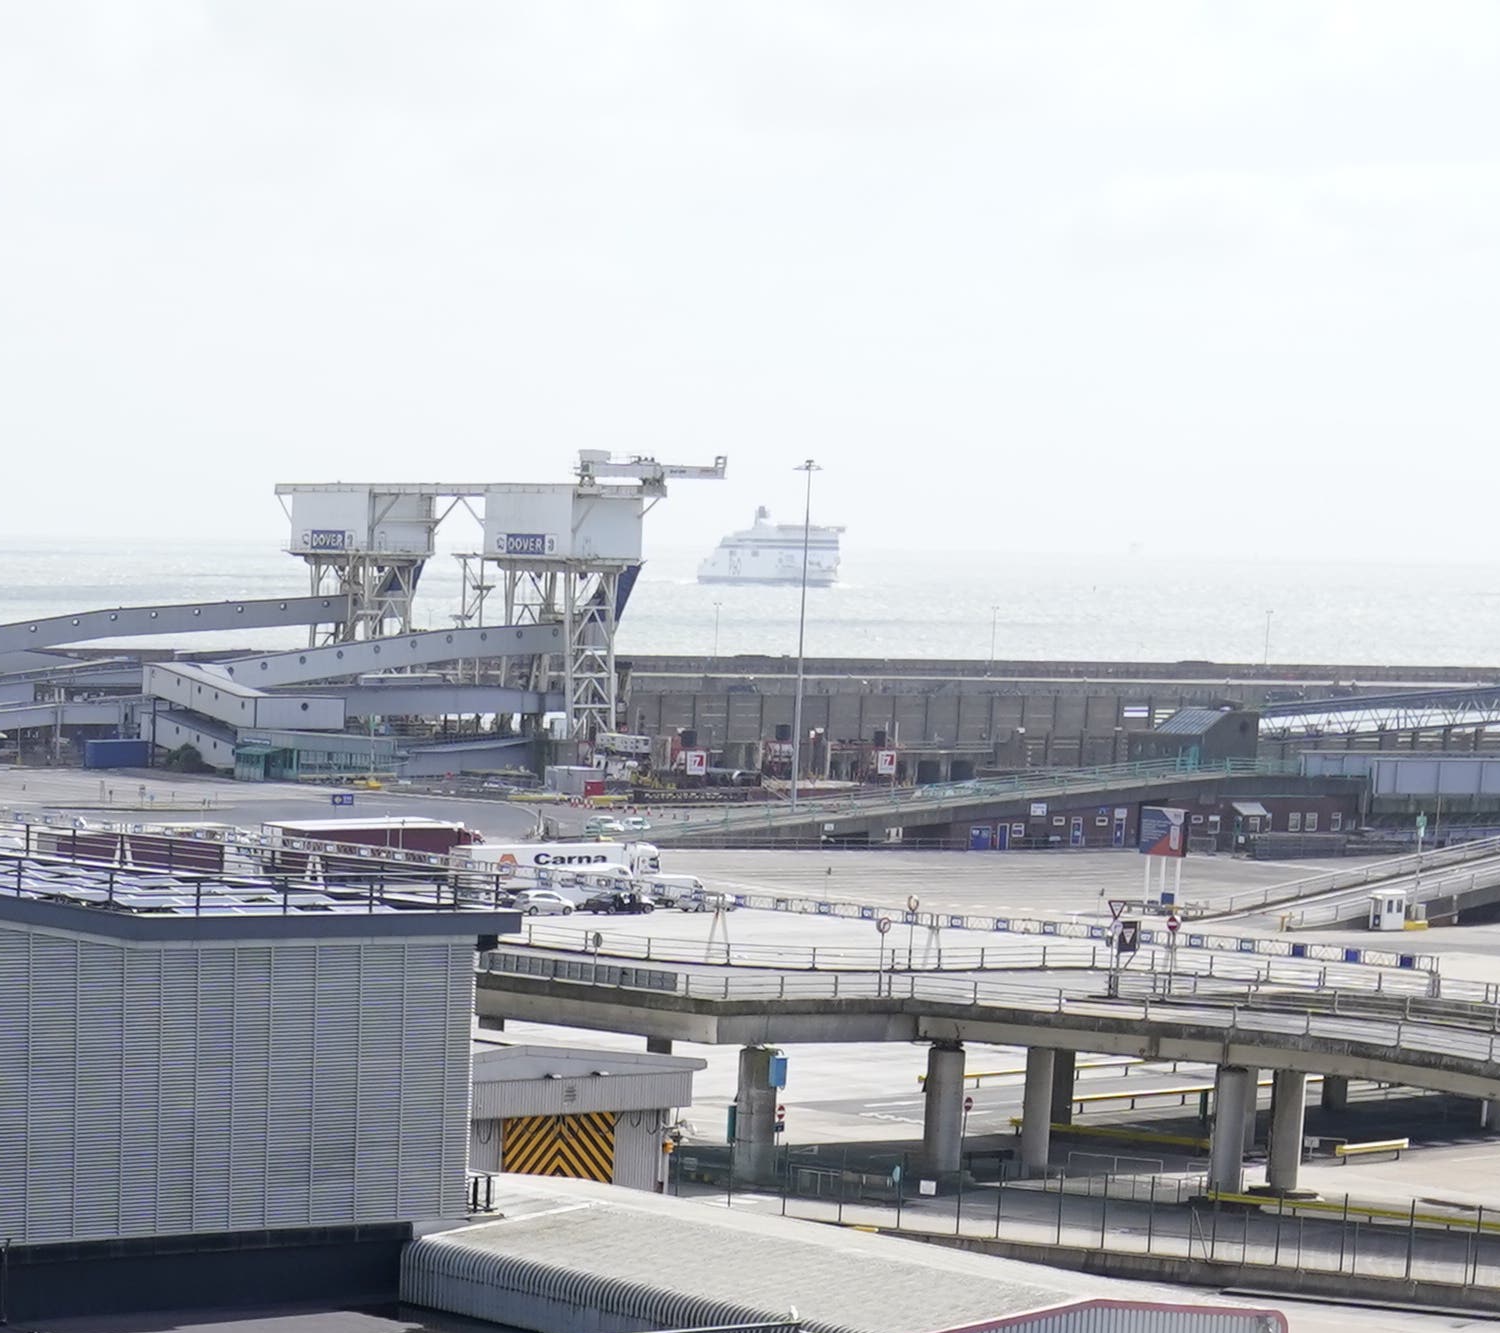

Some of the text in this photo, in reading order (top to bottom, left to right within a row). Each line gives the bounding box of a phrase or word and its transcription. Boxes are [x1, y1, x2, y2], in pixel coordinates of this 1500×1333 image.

[312, 533, 344, 548] DOVER
[508, 537, 542, 551] DOVER
[534, 853, 608, 865] Carna
